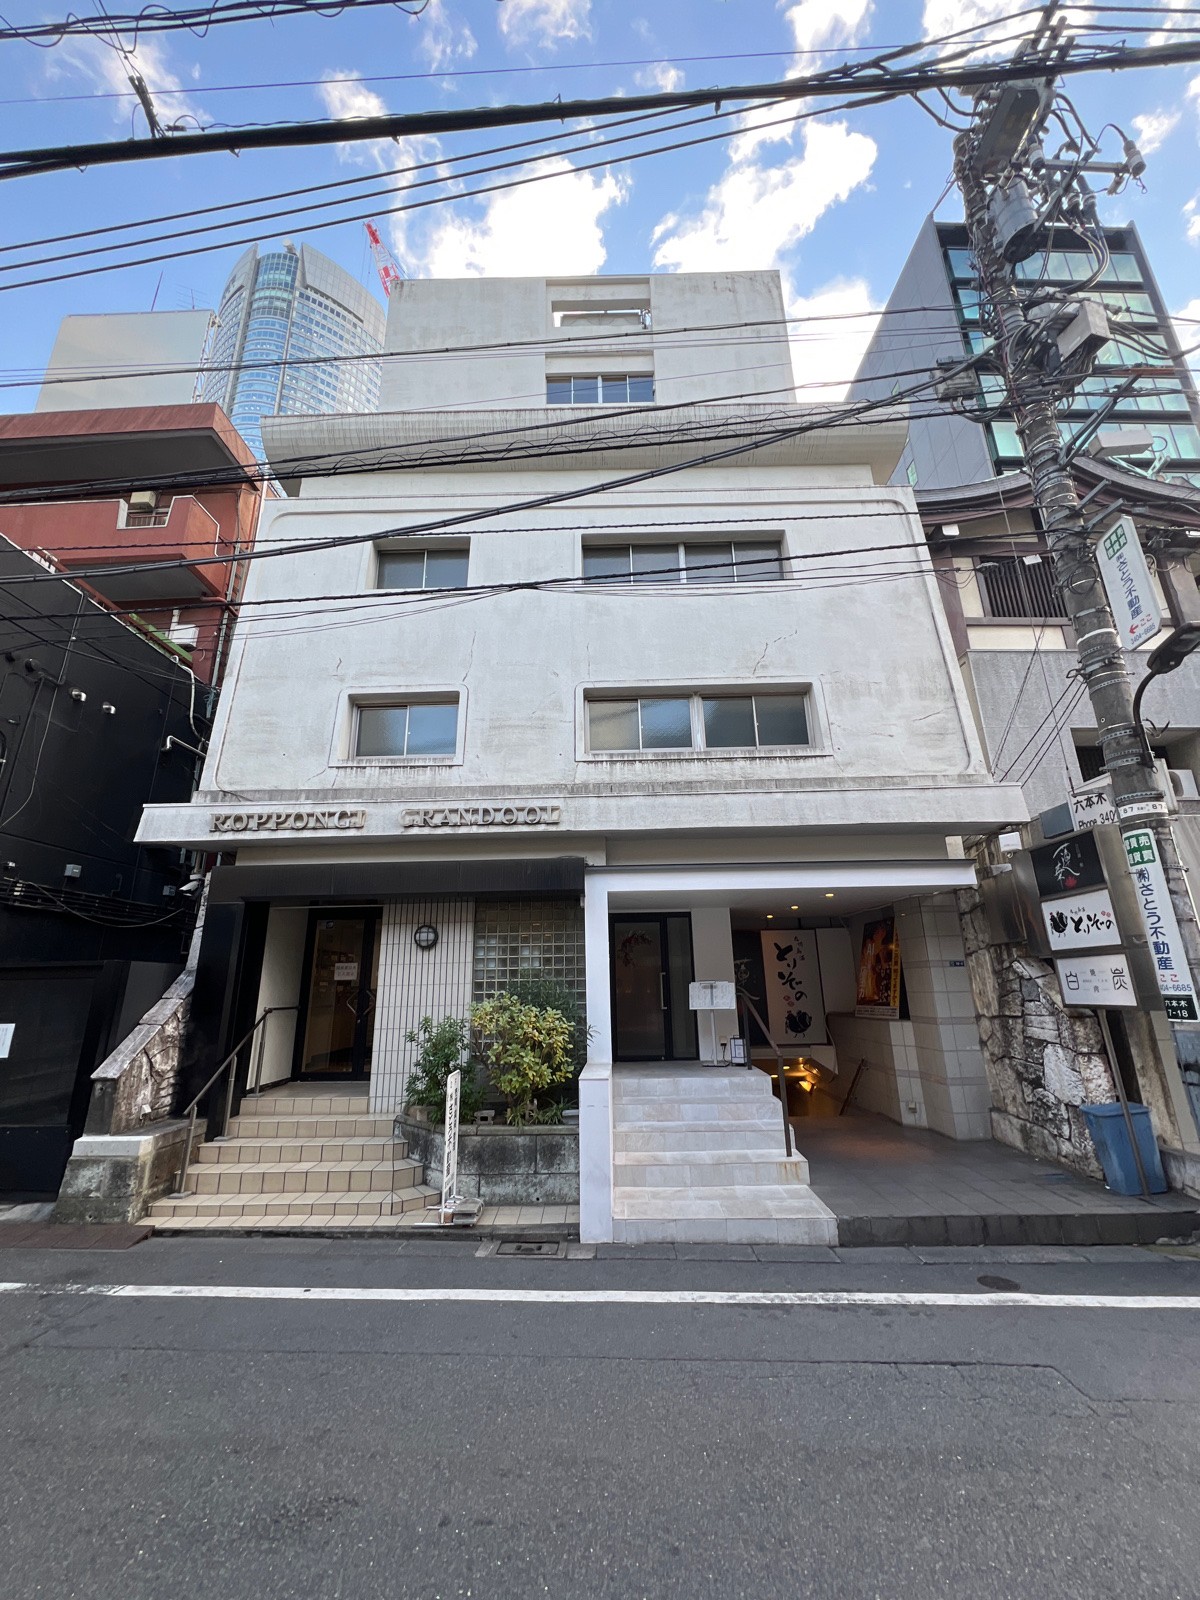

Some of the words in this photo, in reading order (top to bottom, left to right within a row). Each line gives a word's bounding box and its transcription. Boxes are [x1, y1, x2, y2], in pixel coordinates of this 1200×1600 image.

[1073, 792, 1107, 814] 六本木
[209, 809, 367, 832] ROPPONGI
